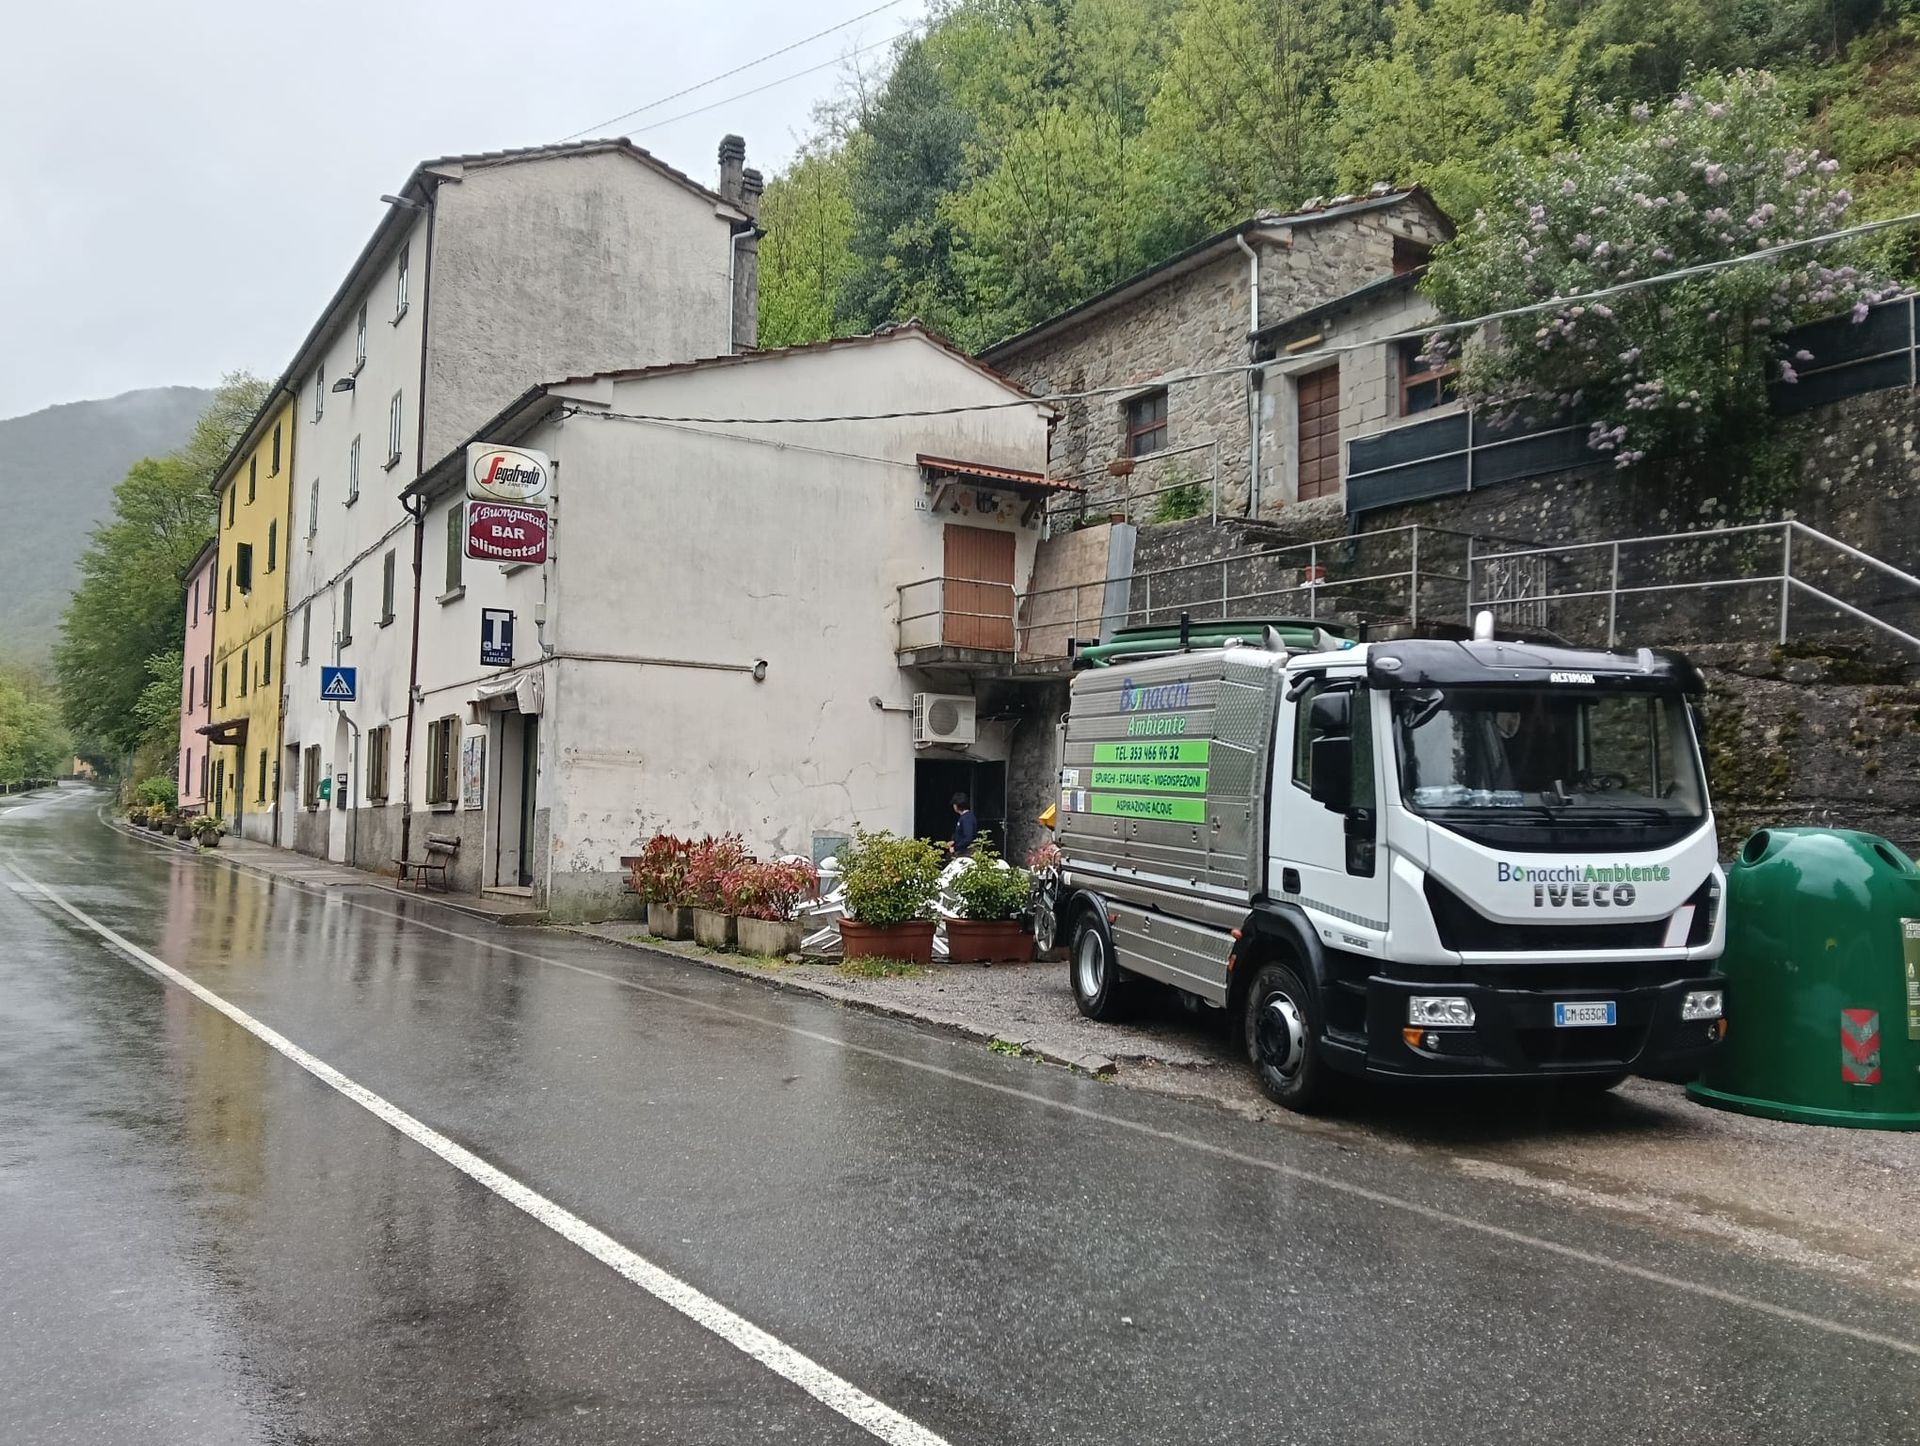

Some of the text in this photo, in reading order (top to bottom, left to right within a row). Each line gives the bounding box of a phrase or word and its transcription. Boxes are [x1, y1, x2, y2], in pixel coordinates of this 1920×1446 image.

[481, 456, 541, 485] Segafredo
[491, 524, 525, 540] BAR
[470, 536, 545, 557] alimentari
[485, 611, 510, 650] T
[1119, 677, 1190, 712] Bonacchi
[1127, 713, 1186, 737] Ambiente
[1115, 745, 1180, 760] TEL 353 466 96 32
[1116, 800, 1173, 816] ASPIRAZIONE ACQUE
[1498, 861, 1671, 883] Bonacchi Ambiente
[1533, 882, 1637, 908] IVECO
